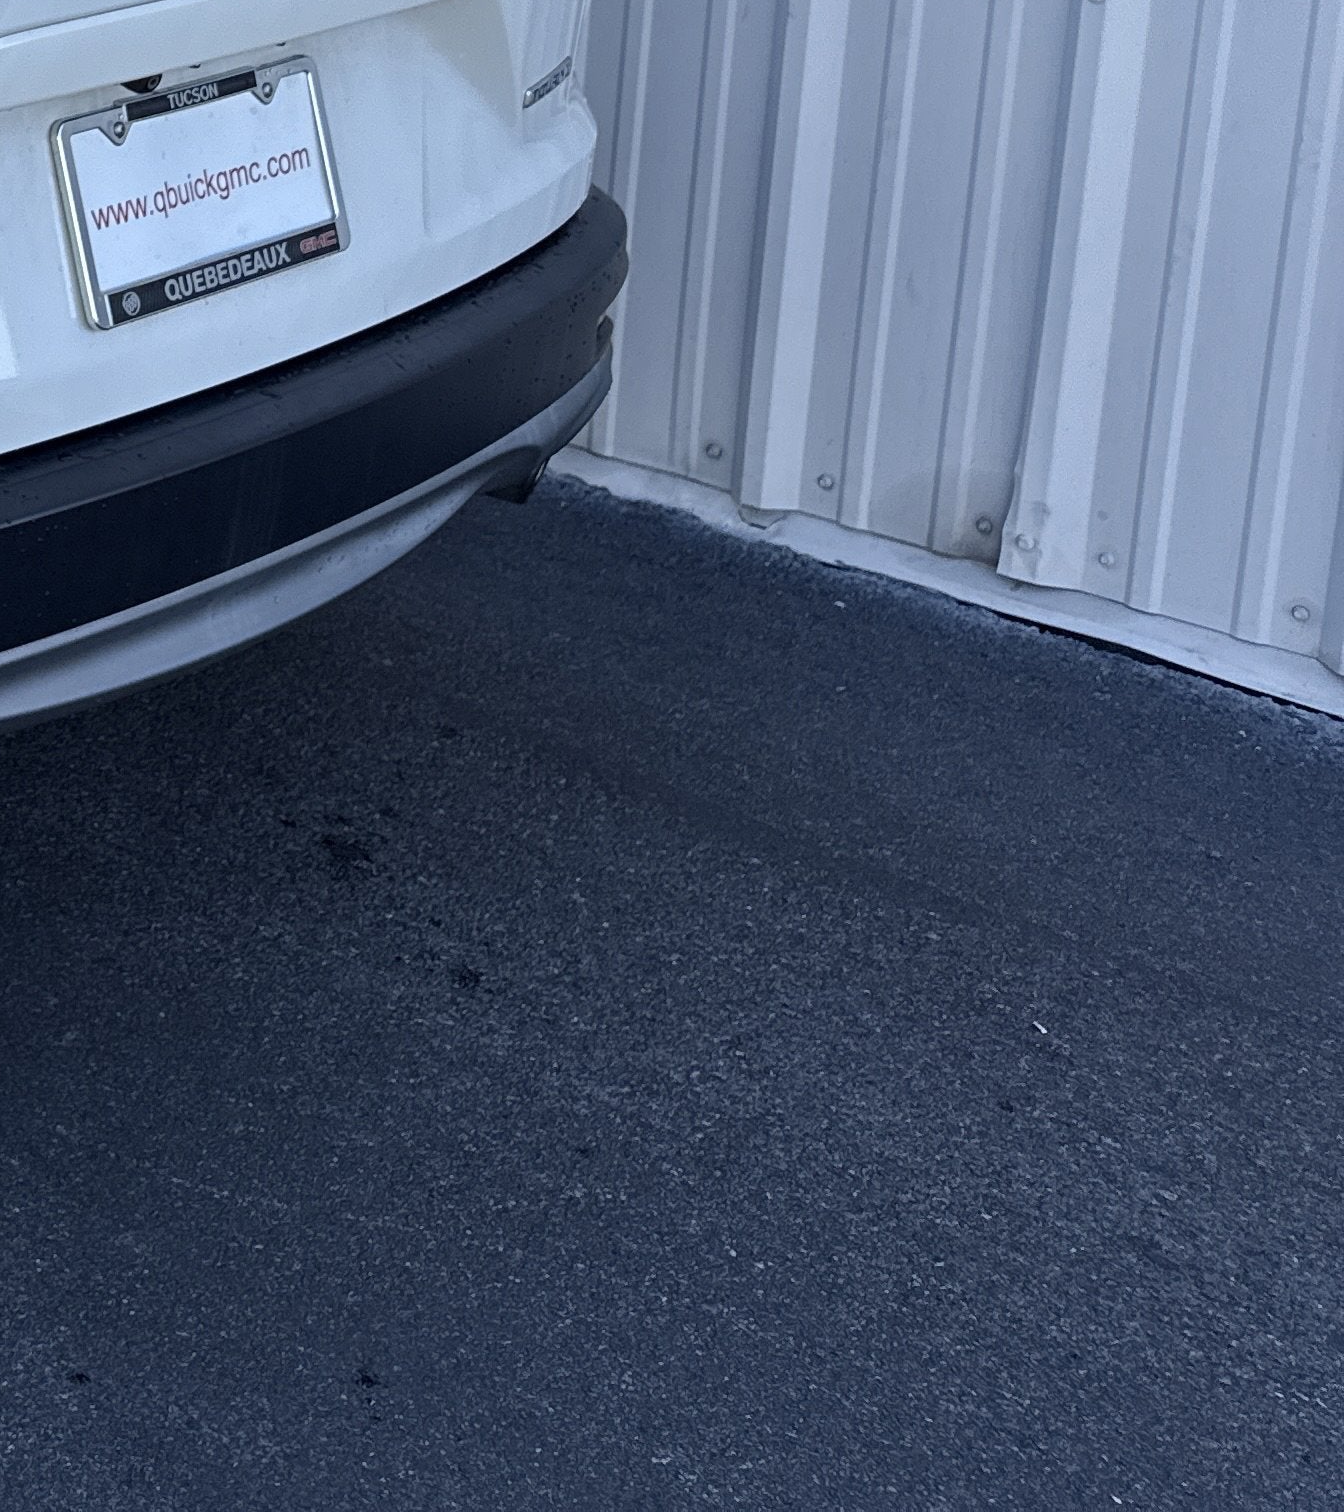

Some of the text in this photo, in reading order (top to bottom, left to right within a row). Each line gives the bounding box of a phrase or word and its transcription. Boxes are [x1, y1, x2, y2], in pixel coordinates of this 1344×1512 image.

[167, 83, 219, 110] TUCSON
[91, 147, 311, 230] www.qbuickgmc.com
[164, 242, 291, 301] QUEBEDEAUX
